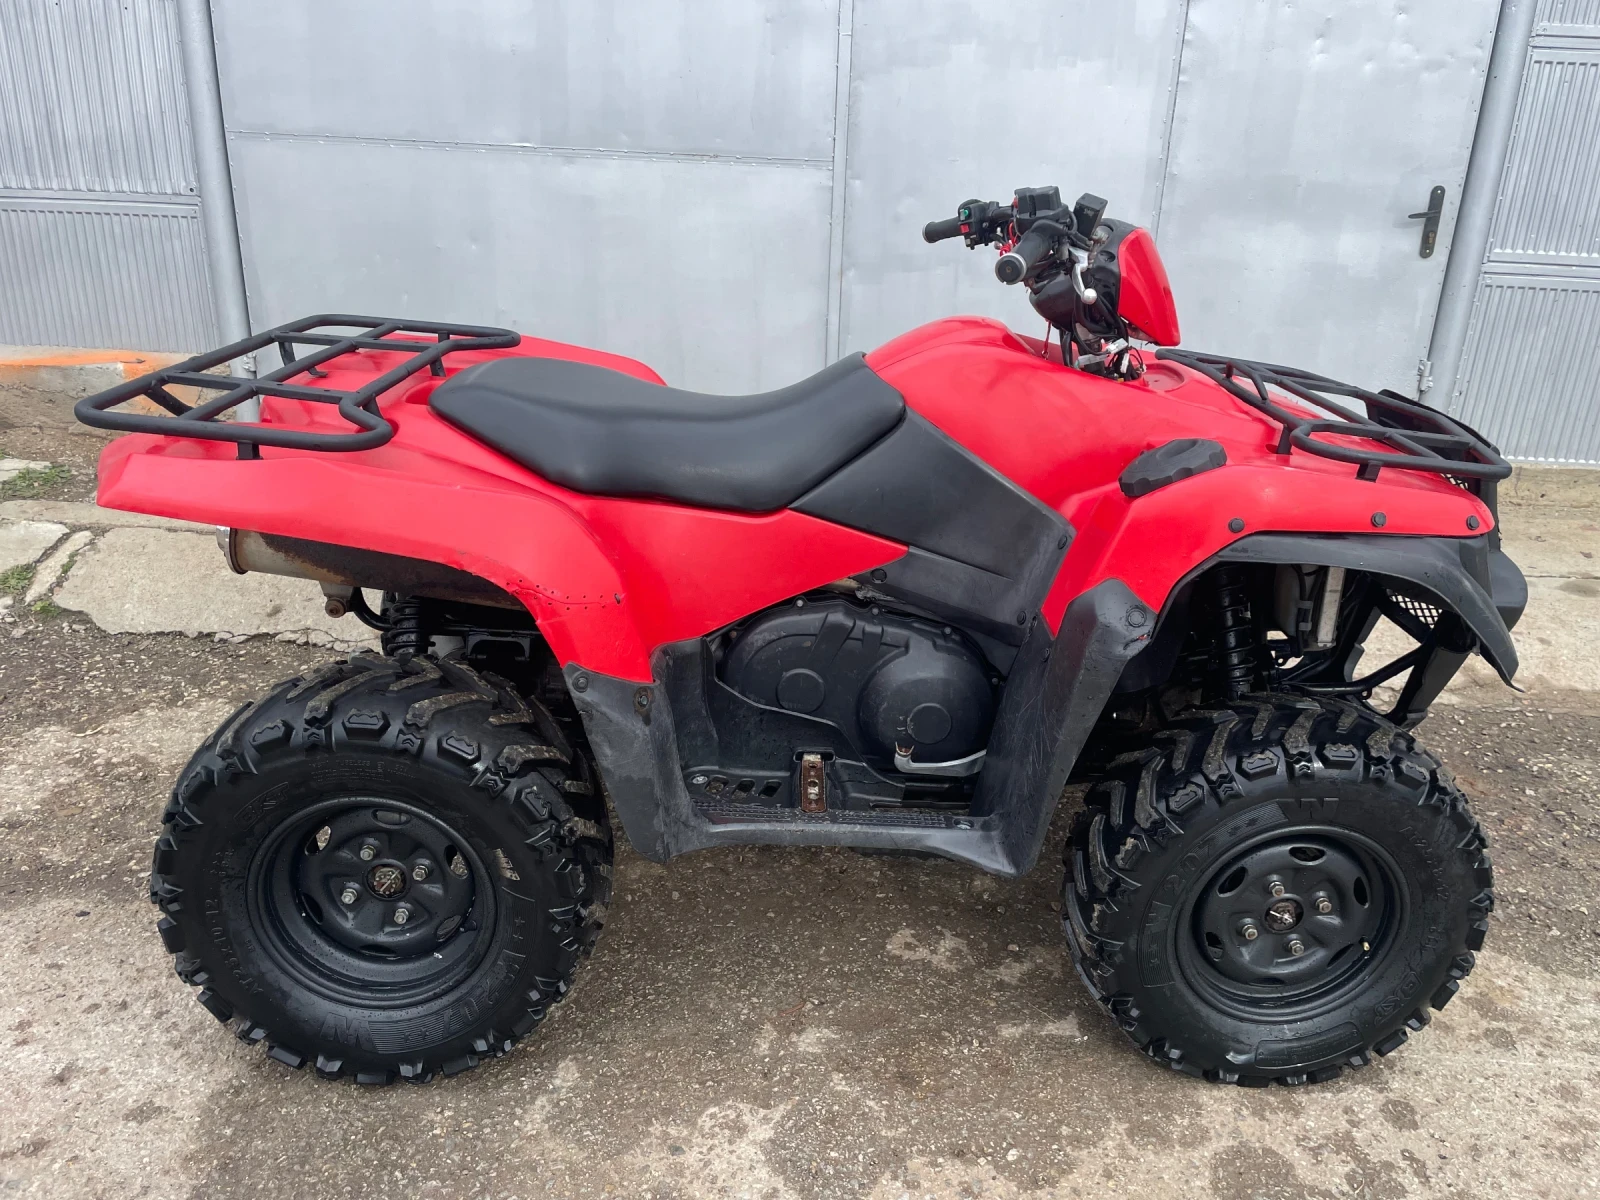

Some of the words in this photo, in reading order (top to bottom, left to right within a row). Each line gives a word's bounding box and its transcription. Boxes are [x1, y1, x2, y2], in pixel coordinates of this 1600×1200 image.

[233, 781, 290, 831] BKT
[1162, 834, 1217, 897] 207
[443, 982, 500, 1037] 207
[1374, 971, 1424, 1027] BKT
